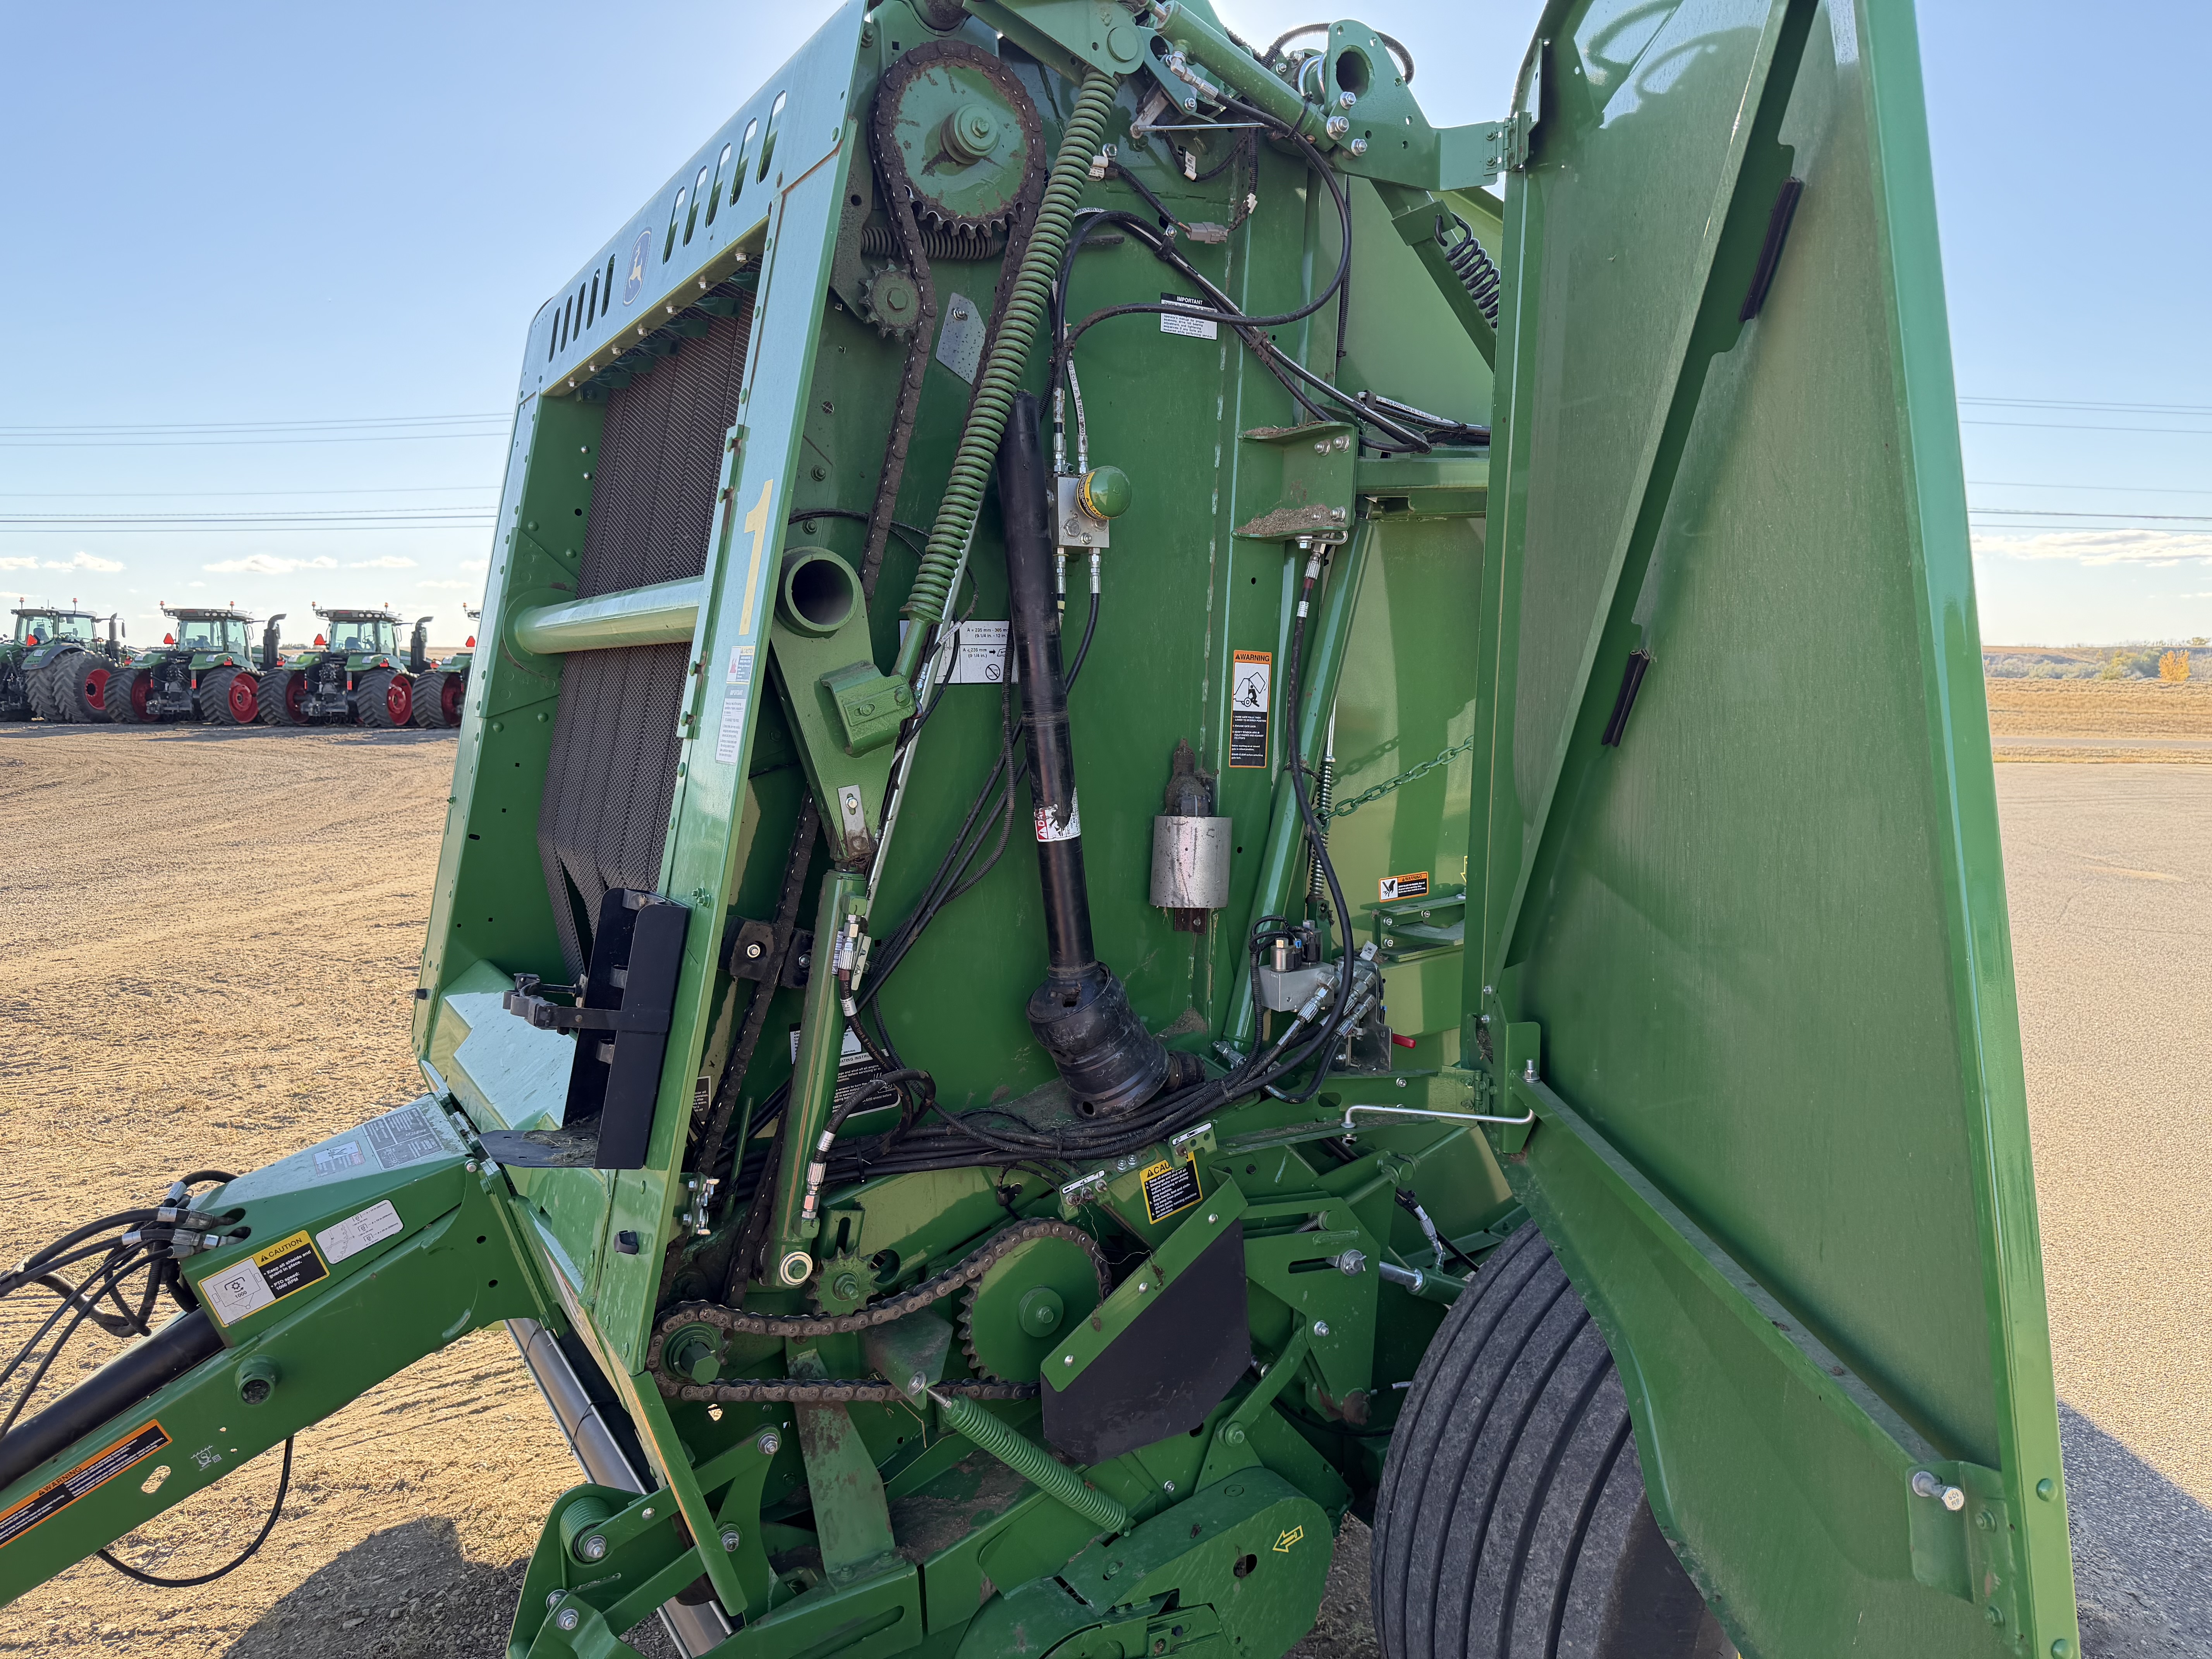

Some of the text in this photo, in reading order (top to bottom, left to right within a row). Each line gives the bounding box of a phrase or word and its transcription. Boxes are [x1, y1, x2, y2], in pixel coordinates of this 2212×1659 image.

[1177, 296, 1202, 305] IMPORTANT
[739, 479, 774, 635] 1
[1240, 654, 1270, 662] WARNING
[268, 1237, 302, 1257] CAUTION
[266, 1266, 279, 1274] Keep
[285, 1254, 302, 1265] shields
[269, 1269, 283, 1278] guard
[288, 1260, 302, 1269] place.
[284, 1272, 300, 1282] speed:
[234, 1290, 247, 1299] 1000
[45, 1465, 82, 1492] WARNING
